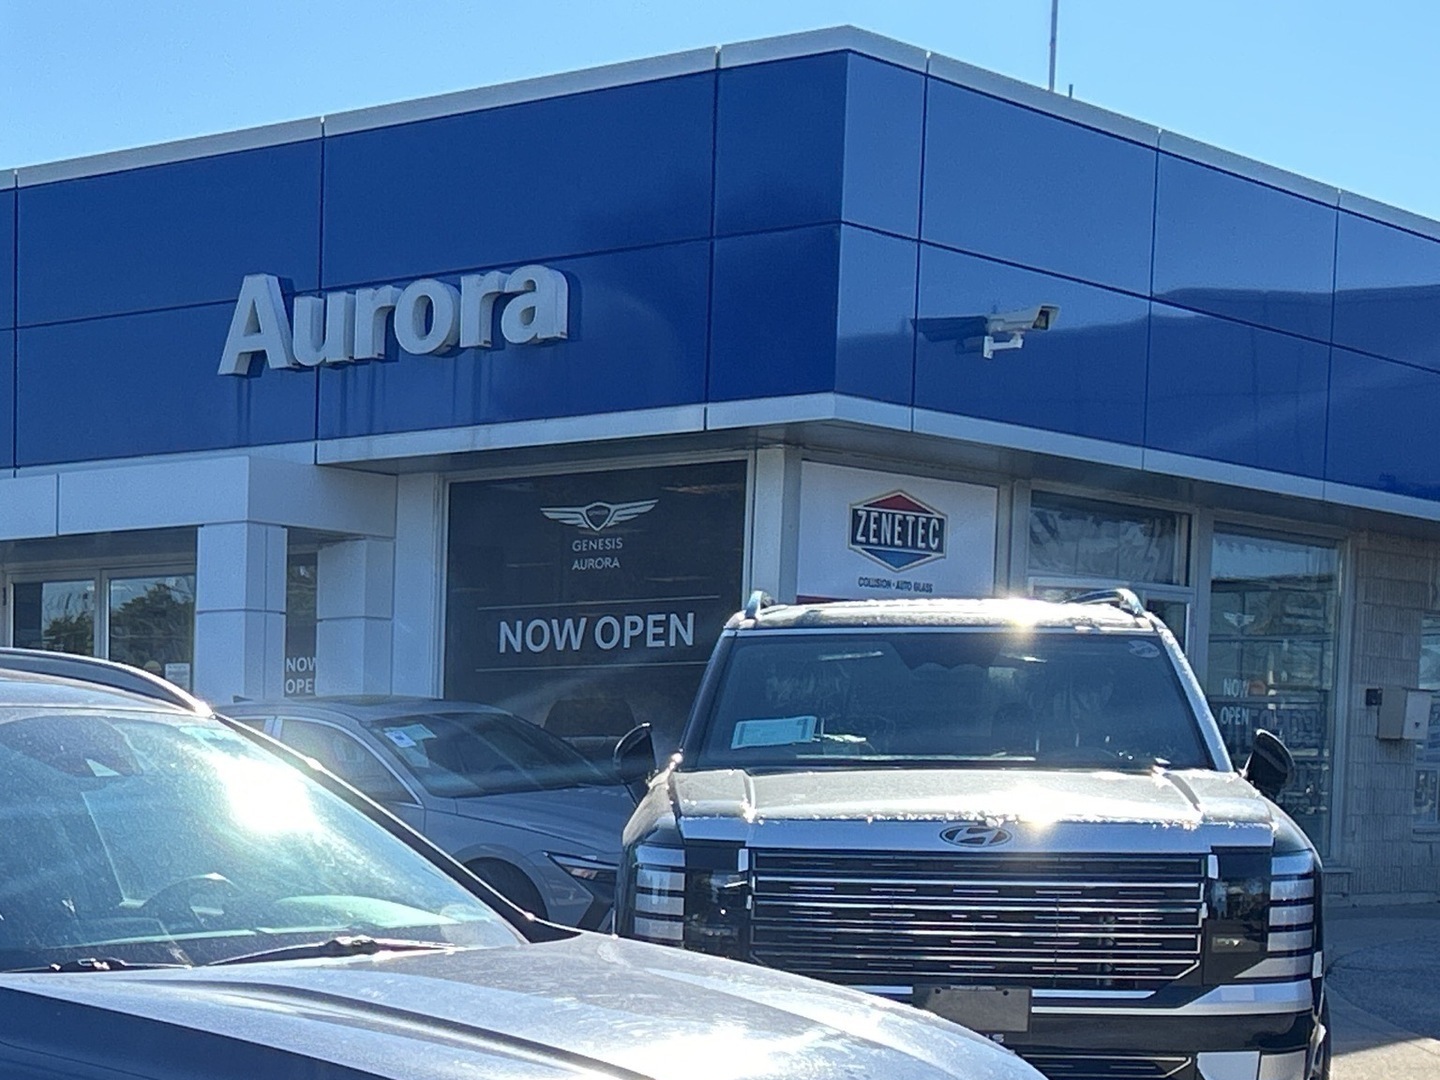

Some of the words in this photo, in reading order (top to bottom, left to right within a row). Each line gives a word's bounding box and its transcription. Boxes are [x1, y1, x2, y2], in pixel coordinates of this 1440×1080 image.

[216, 264, 570, 376] Aurora
[855, 510, 940, 550] ZENETEC
[572, 537, 623, 552] GENESIS
[571, 557, 621, 571] AURORA
[499, 616, 588, 653] NOW
[594, 612, 695, 650] OPEN
[285, 678, 314, 694] OPE
[1223, 678, 1250, 698] NOW
[1220, 705, 1250, 726] OPEN
